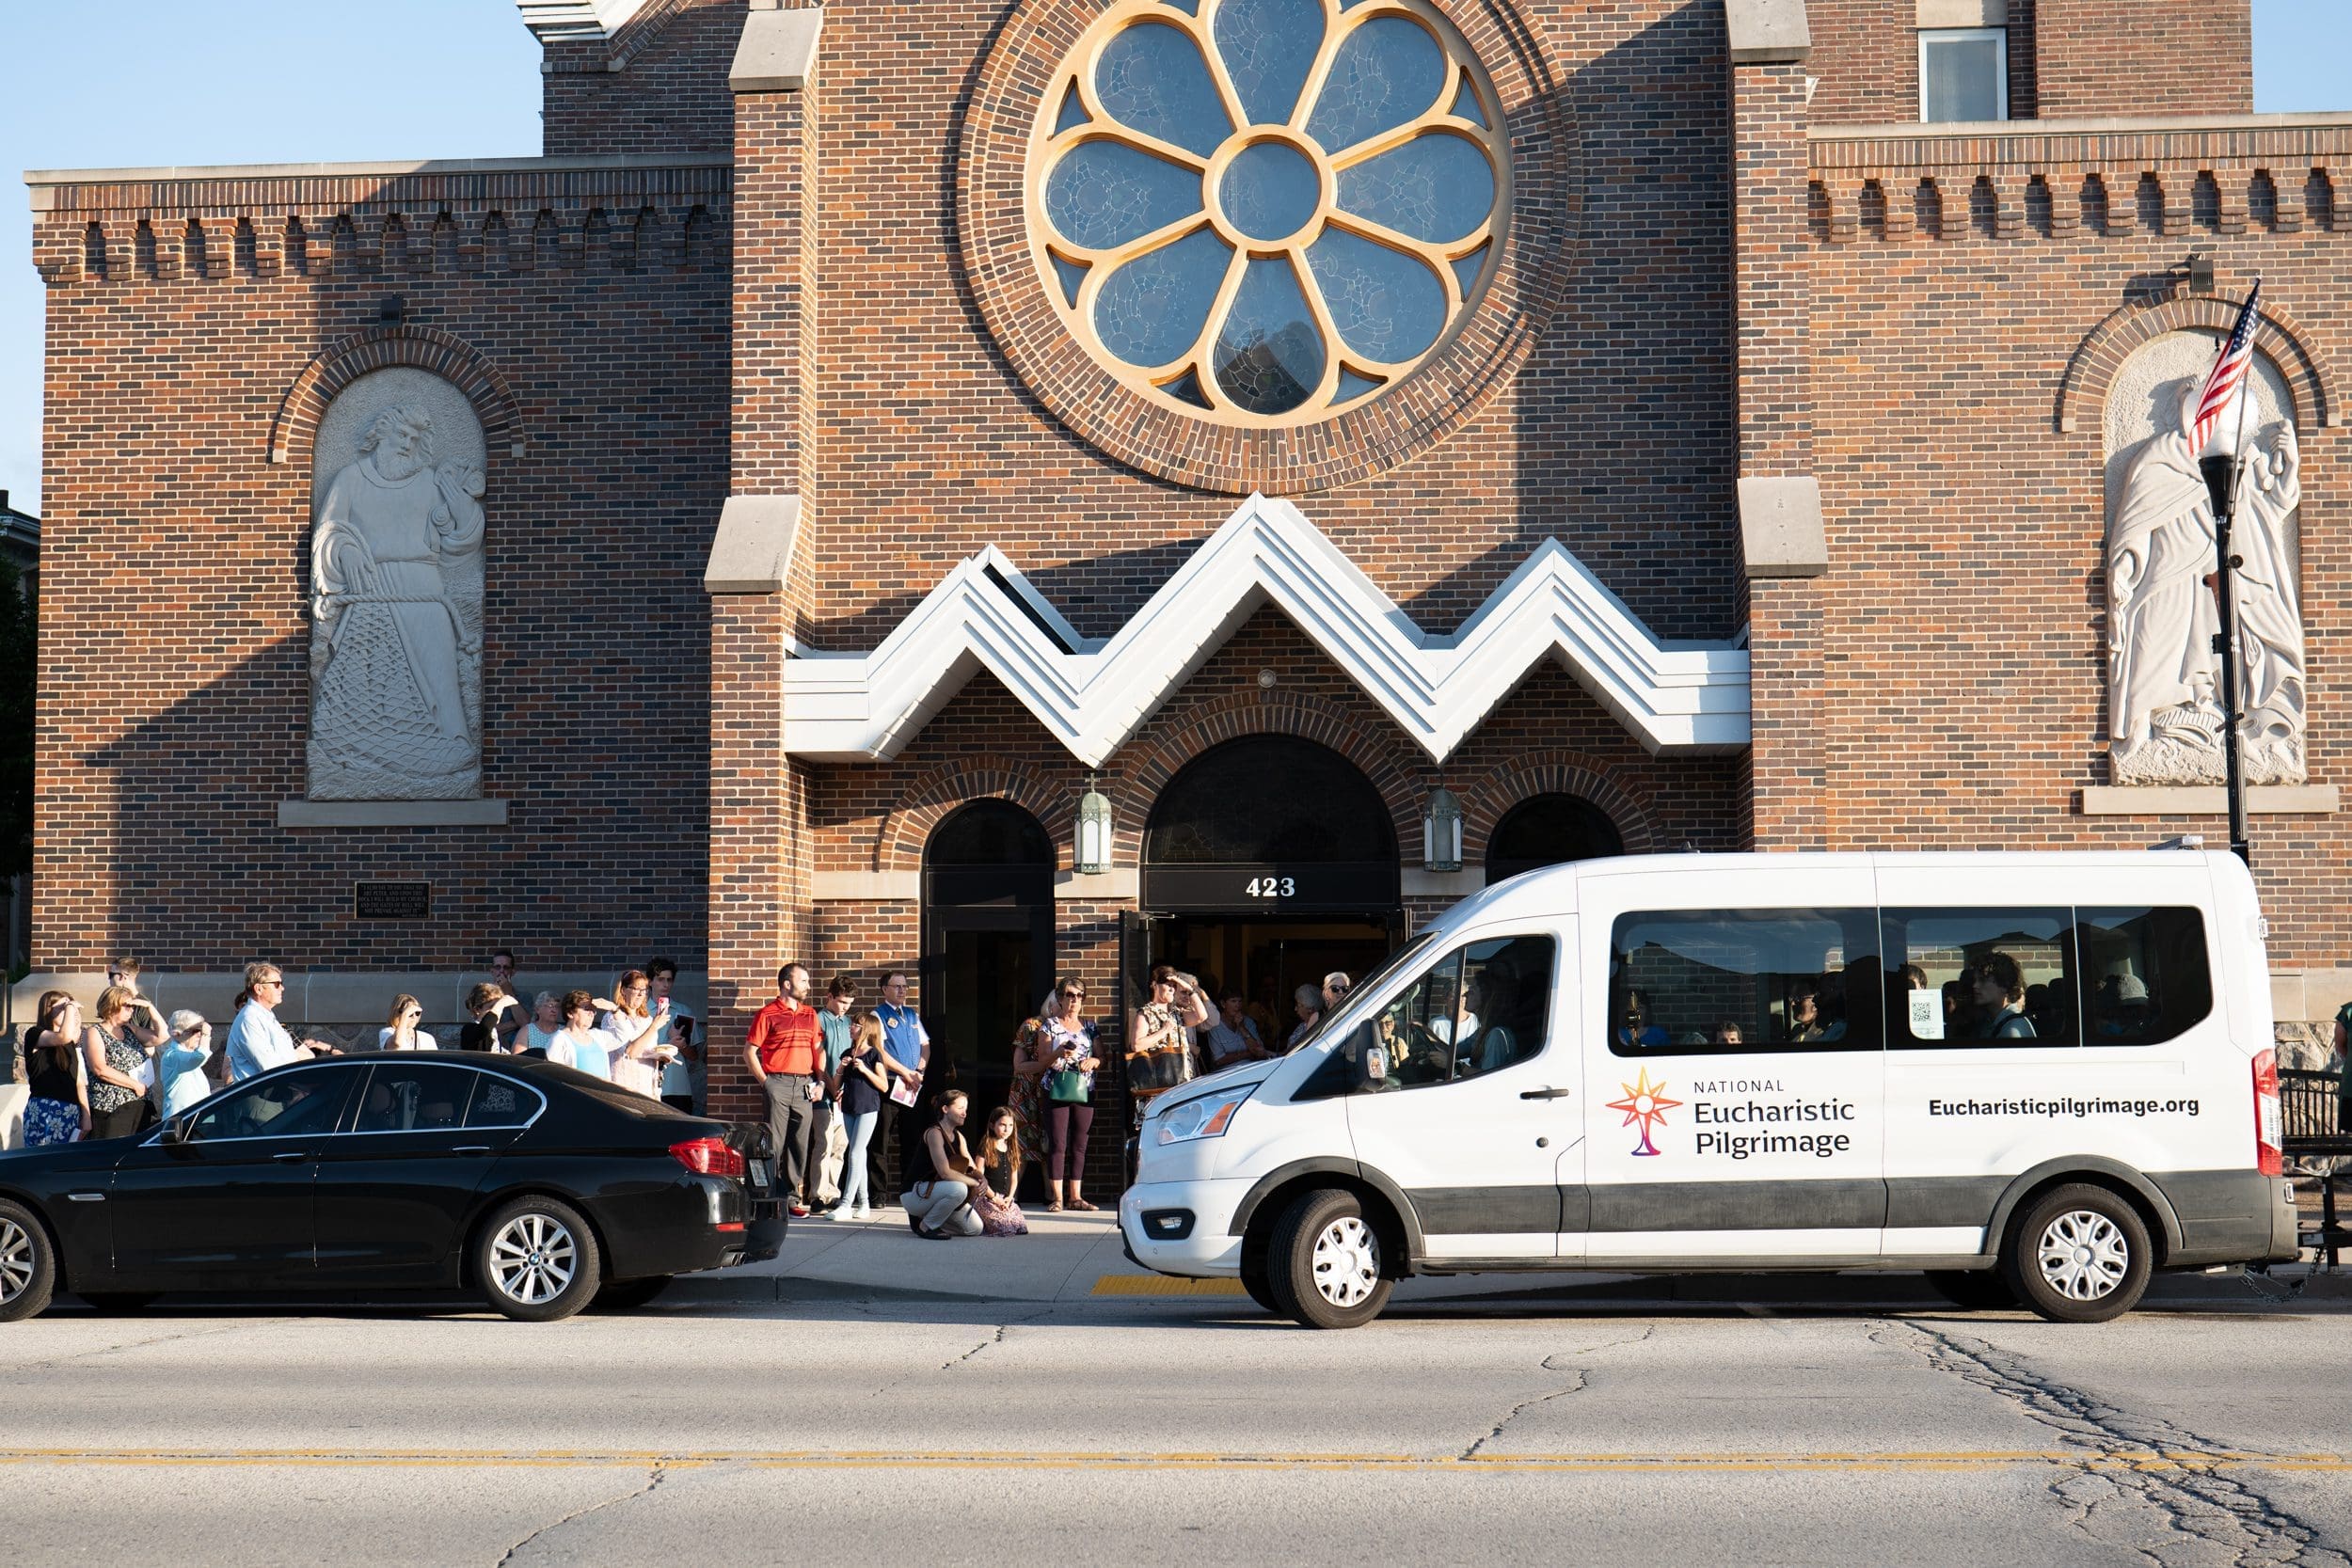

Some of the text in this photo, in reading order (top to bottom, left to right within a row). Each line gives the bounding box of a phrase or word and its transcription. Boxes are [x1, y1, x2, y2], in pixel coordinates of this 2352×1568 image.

[1246, 878, 1295, 897] 423
[1693, 1079, 1785, 1094] NATIONAL
[1694, 1097, 1855, 1124] Eucharistic
[1929, 1097, 2200, 1118] Eucharisticpilgrimage.org
[1695, 1130, 1851, 1160] Pilgrimage
